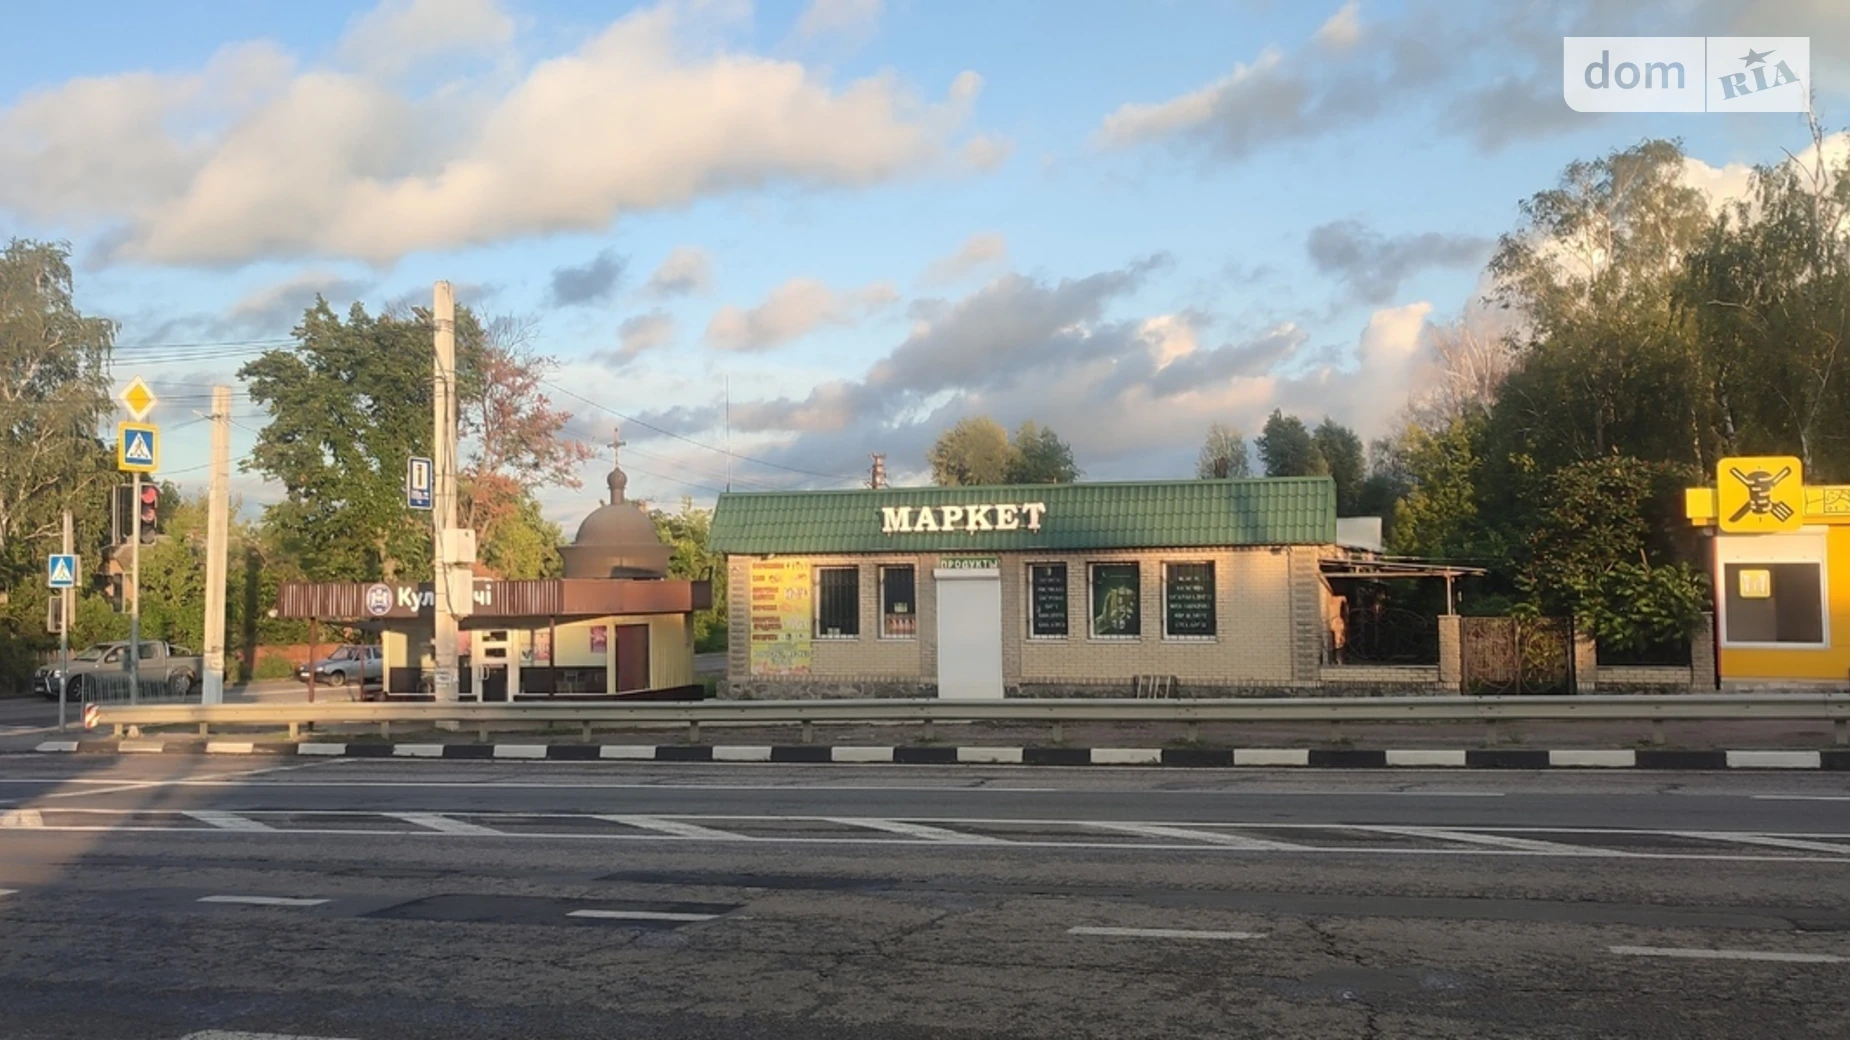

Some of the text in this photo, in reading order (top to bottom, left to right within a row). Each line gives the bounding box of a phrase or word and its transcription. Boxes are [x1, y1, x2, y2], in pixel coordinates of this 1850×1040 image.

[882, 502, 1046, 533] МАРКЕТ
[940, 559, 998, 569] ПРОДУКТЫ
[397, 584, 491, 612] Кулчі
